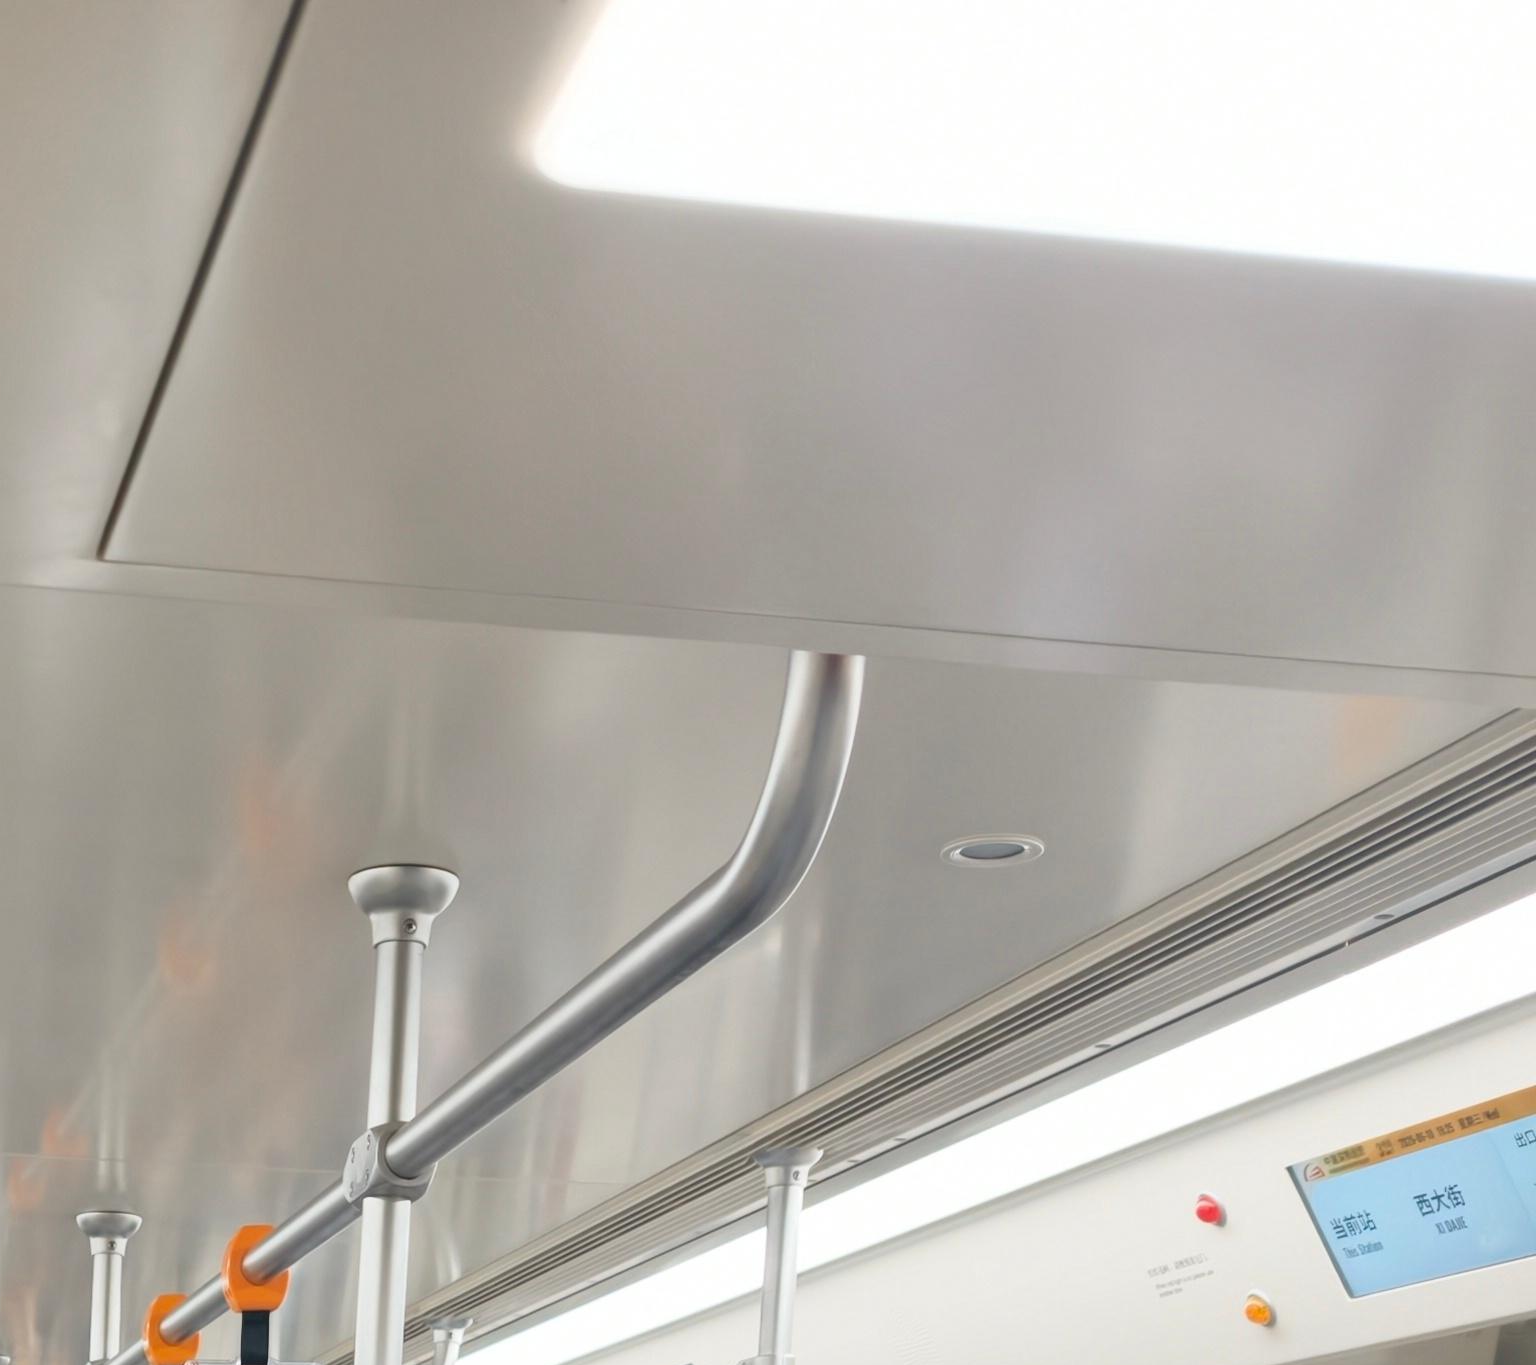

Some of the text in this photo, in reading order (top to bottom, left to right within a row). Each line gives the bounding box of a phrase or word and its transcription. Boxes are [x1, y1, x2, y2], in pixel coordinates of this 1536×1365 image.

[1413, 1184, 1466, 1217] 西大街
[1330, 1210, 1378, 1239] 当前站
